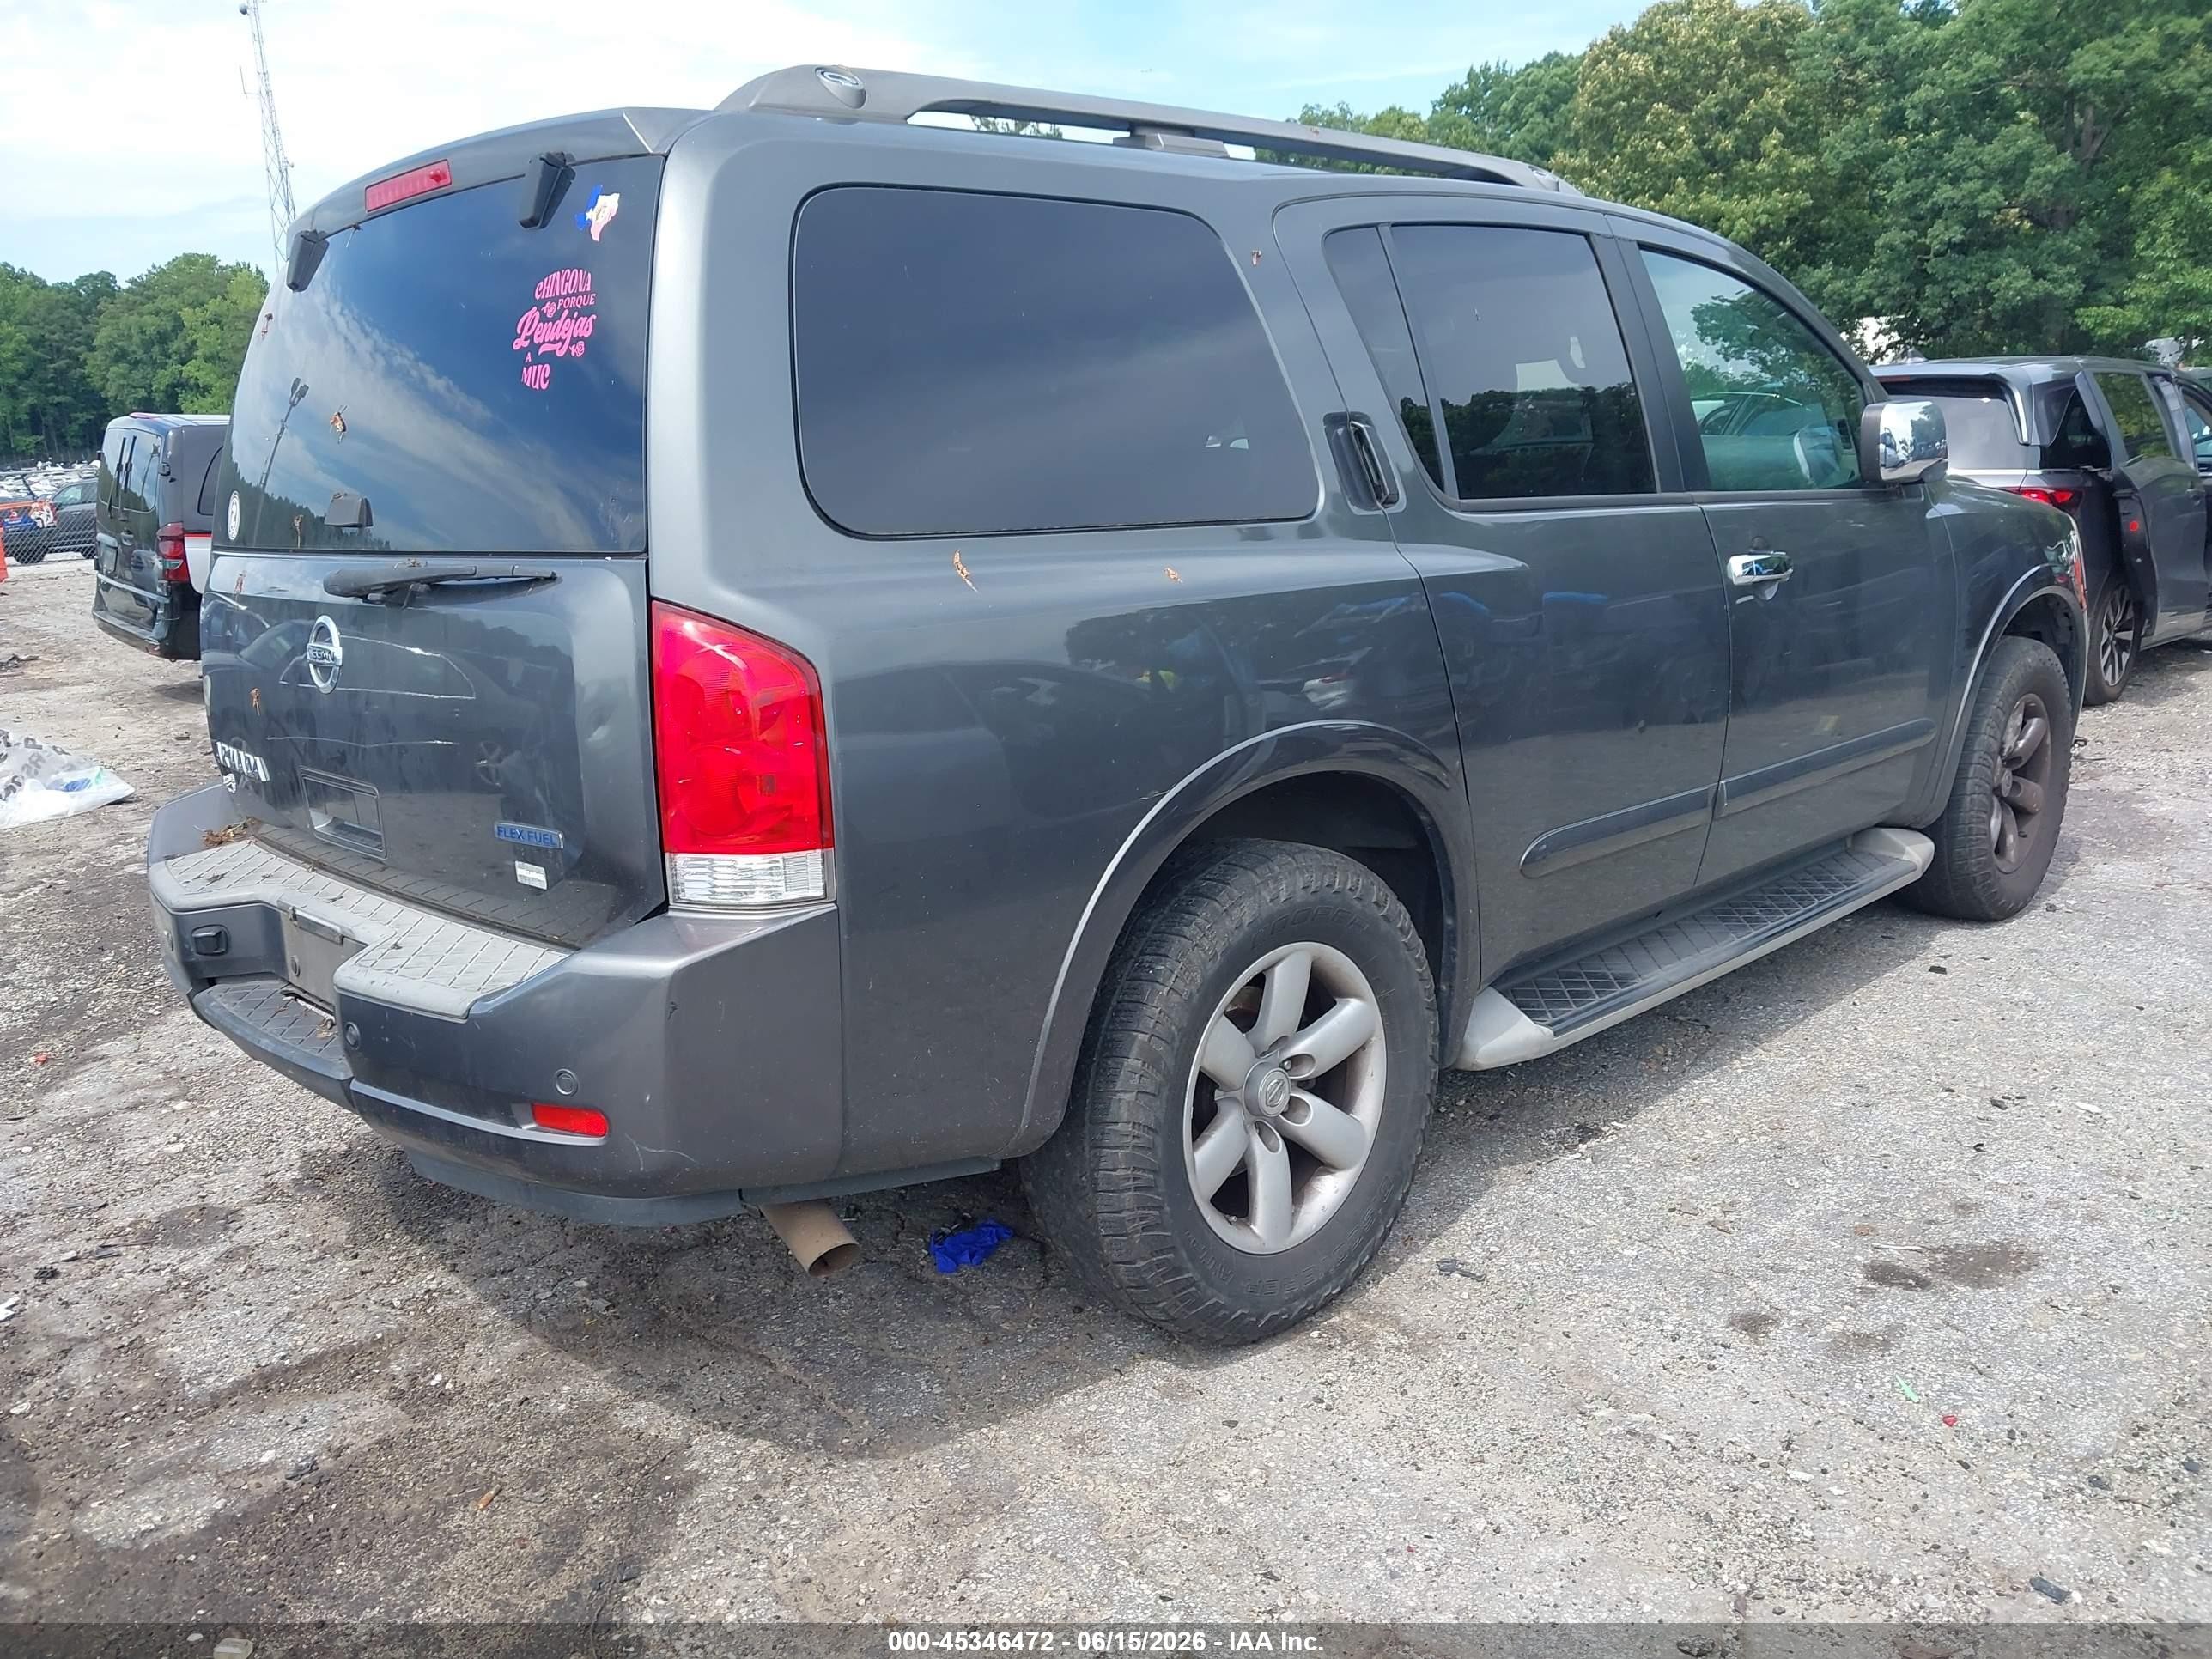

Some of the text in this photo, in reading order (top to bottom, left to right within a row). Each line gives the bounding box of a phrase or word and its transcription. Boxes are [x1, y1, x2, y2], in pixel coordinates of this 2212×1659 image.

[535, 269, 592, 301] CHINGONA
[557, 294, 596, 310] PORQUE
[513, 307, 596, 357] Pendejas
[497, 826, 557, 846] FLEX FUEL
